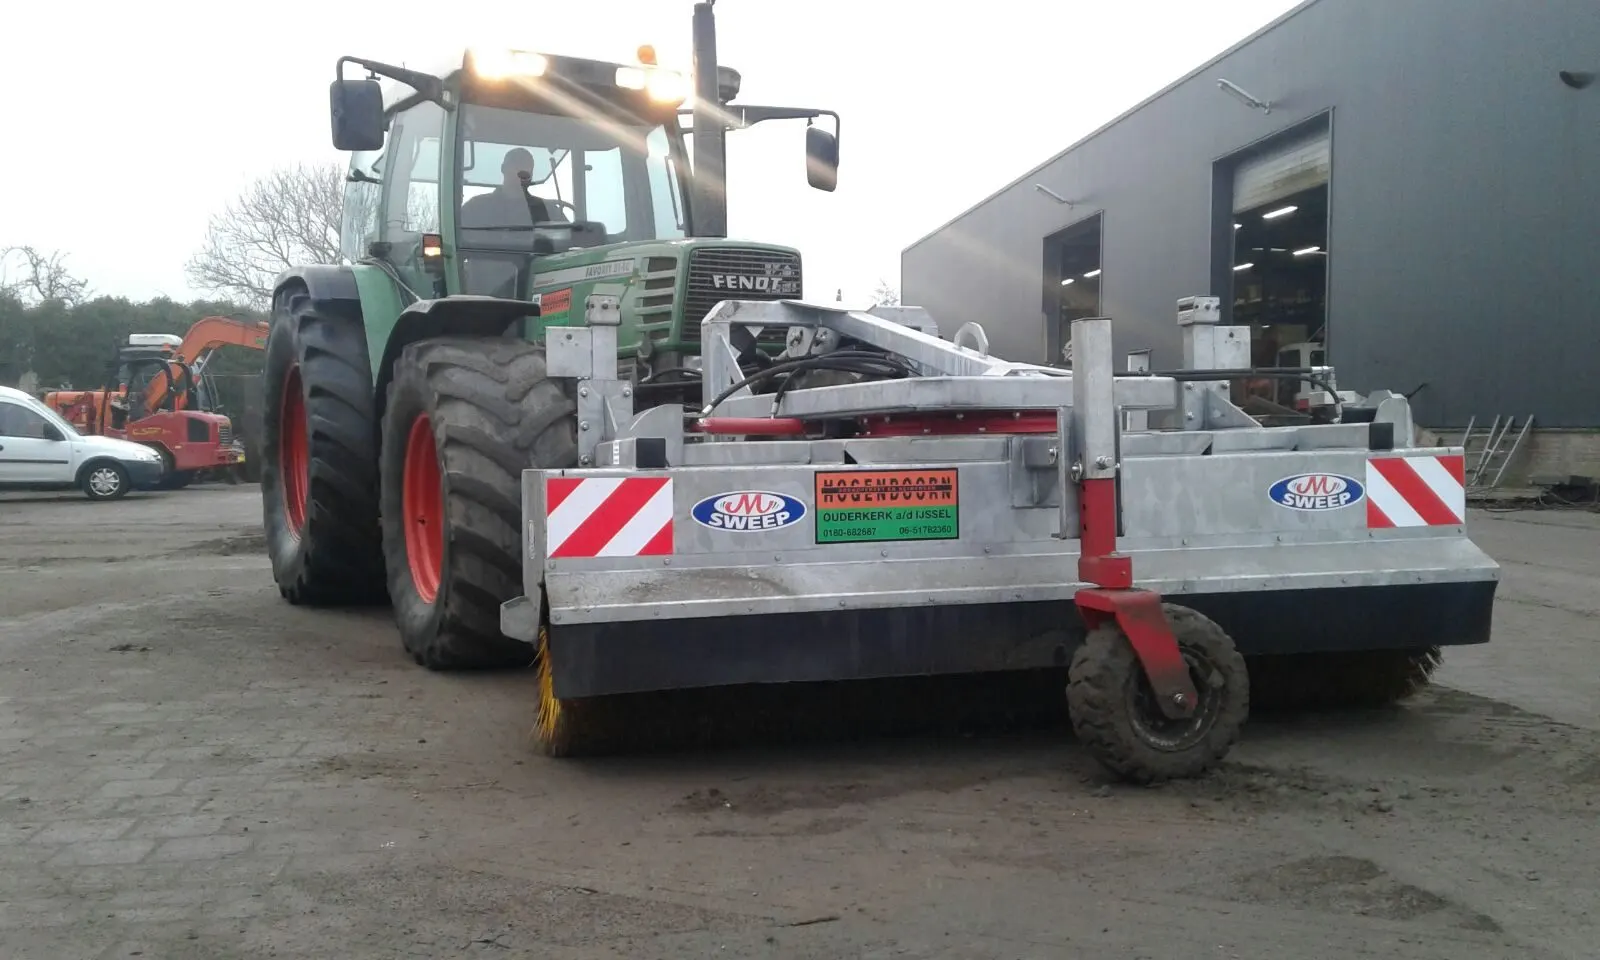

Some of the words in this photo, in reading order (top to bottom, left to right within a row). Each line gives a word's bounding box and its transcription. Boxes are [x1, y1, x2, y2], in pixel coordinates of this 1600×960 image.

[712, 274, 783, 290] FENDT
[823, 476, 952, 503] HOGENDOORN
[1282, 491, 1351, 509] SWEEP
[708, 510, 790, 530] SWEEP
[823, 511, 893, 522] OUDERKERK
[895, 510, 913, 520] a/d
[915, 509, 951, 520] IJSSEL
